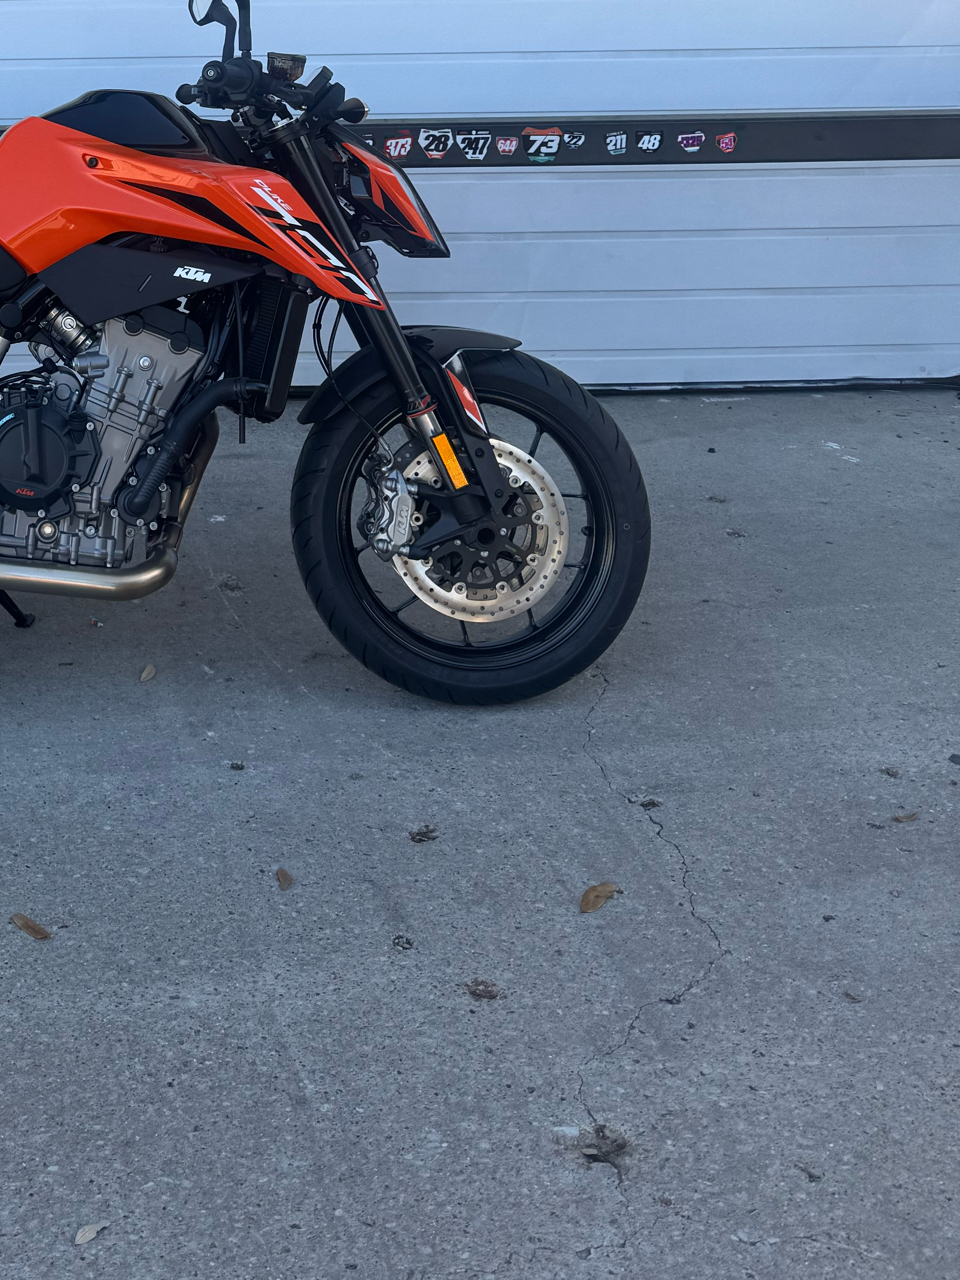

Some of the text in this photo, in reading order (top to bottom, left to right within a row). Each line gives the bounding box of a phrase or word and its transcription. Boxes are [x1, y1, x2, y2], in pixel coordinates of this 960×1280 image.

[386, 137, 412, 157] 373
[423, 133, 450, 153] 28
[460, 136, 490, 155] 247
[527, 135, 560, 153] 73
[606, 134, 627, 151] 211
[638, 135, 661, 150] 48
[253, 179, 293, 211] DUKE
[173, 265, 211, 283] KTM
[16, 487, 35, 496] KTM
